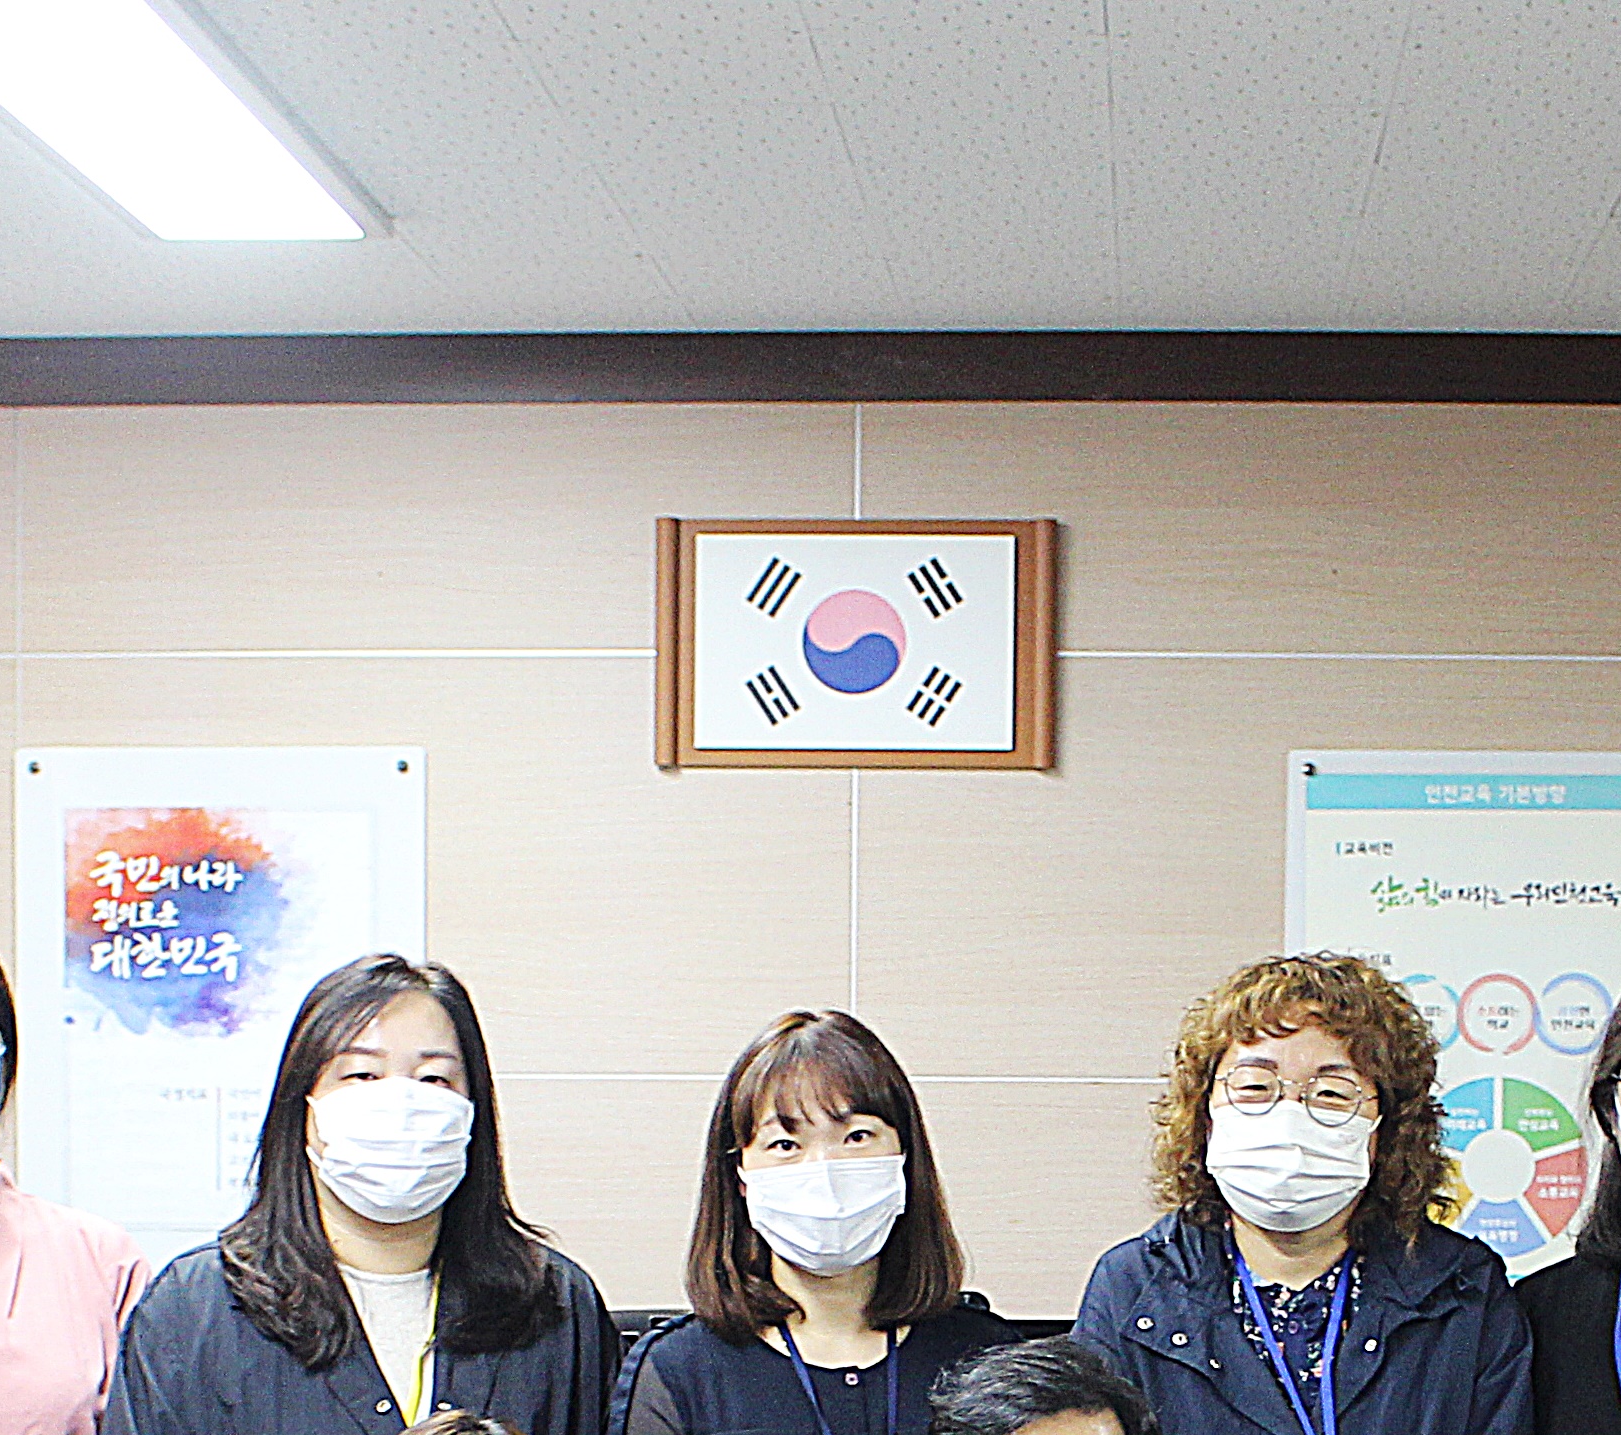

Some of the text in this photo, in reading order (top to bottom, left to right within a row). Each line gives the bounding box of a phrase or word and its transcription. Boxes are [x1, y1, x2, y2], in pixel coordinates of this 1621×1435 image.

[1425, 784, 1566, 804] 인천교육 기본방향
[89, 850, 244, 898] 국민의 나라
[92, 898, 180, 933] 정의로운
[90, 931, 243, 982] 대한민국
